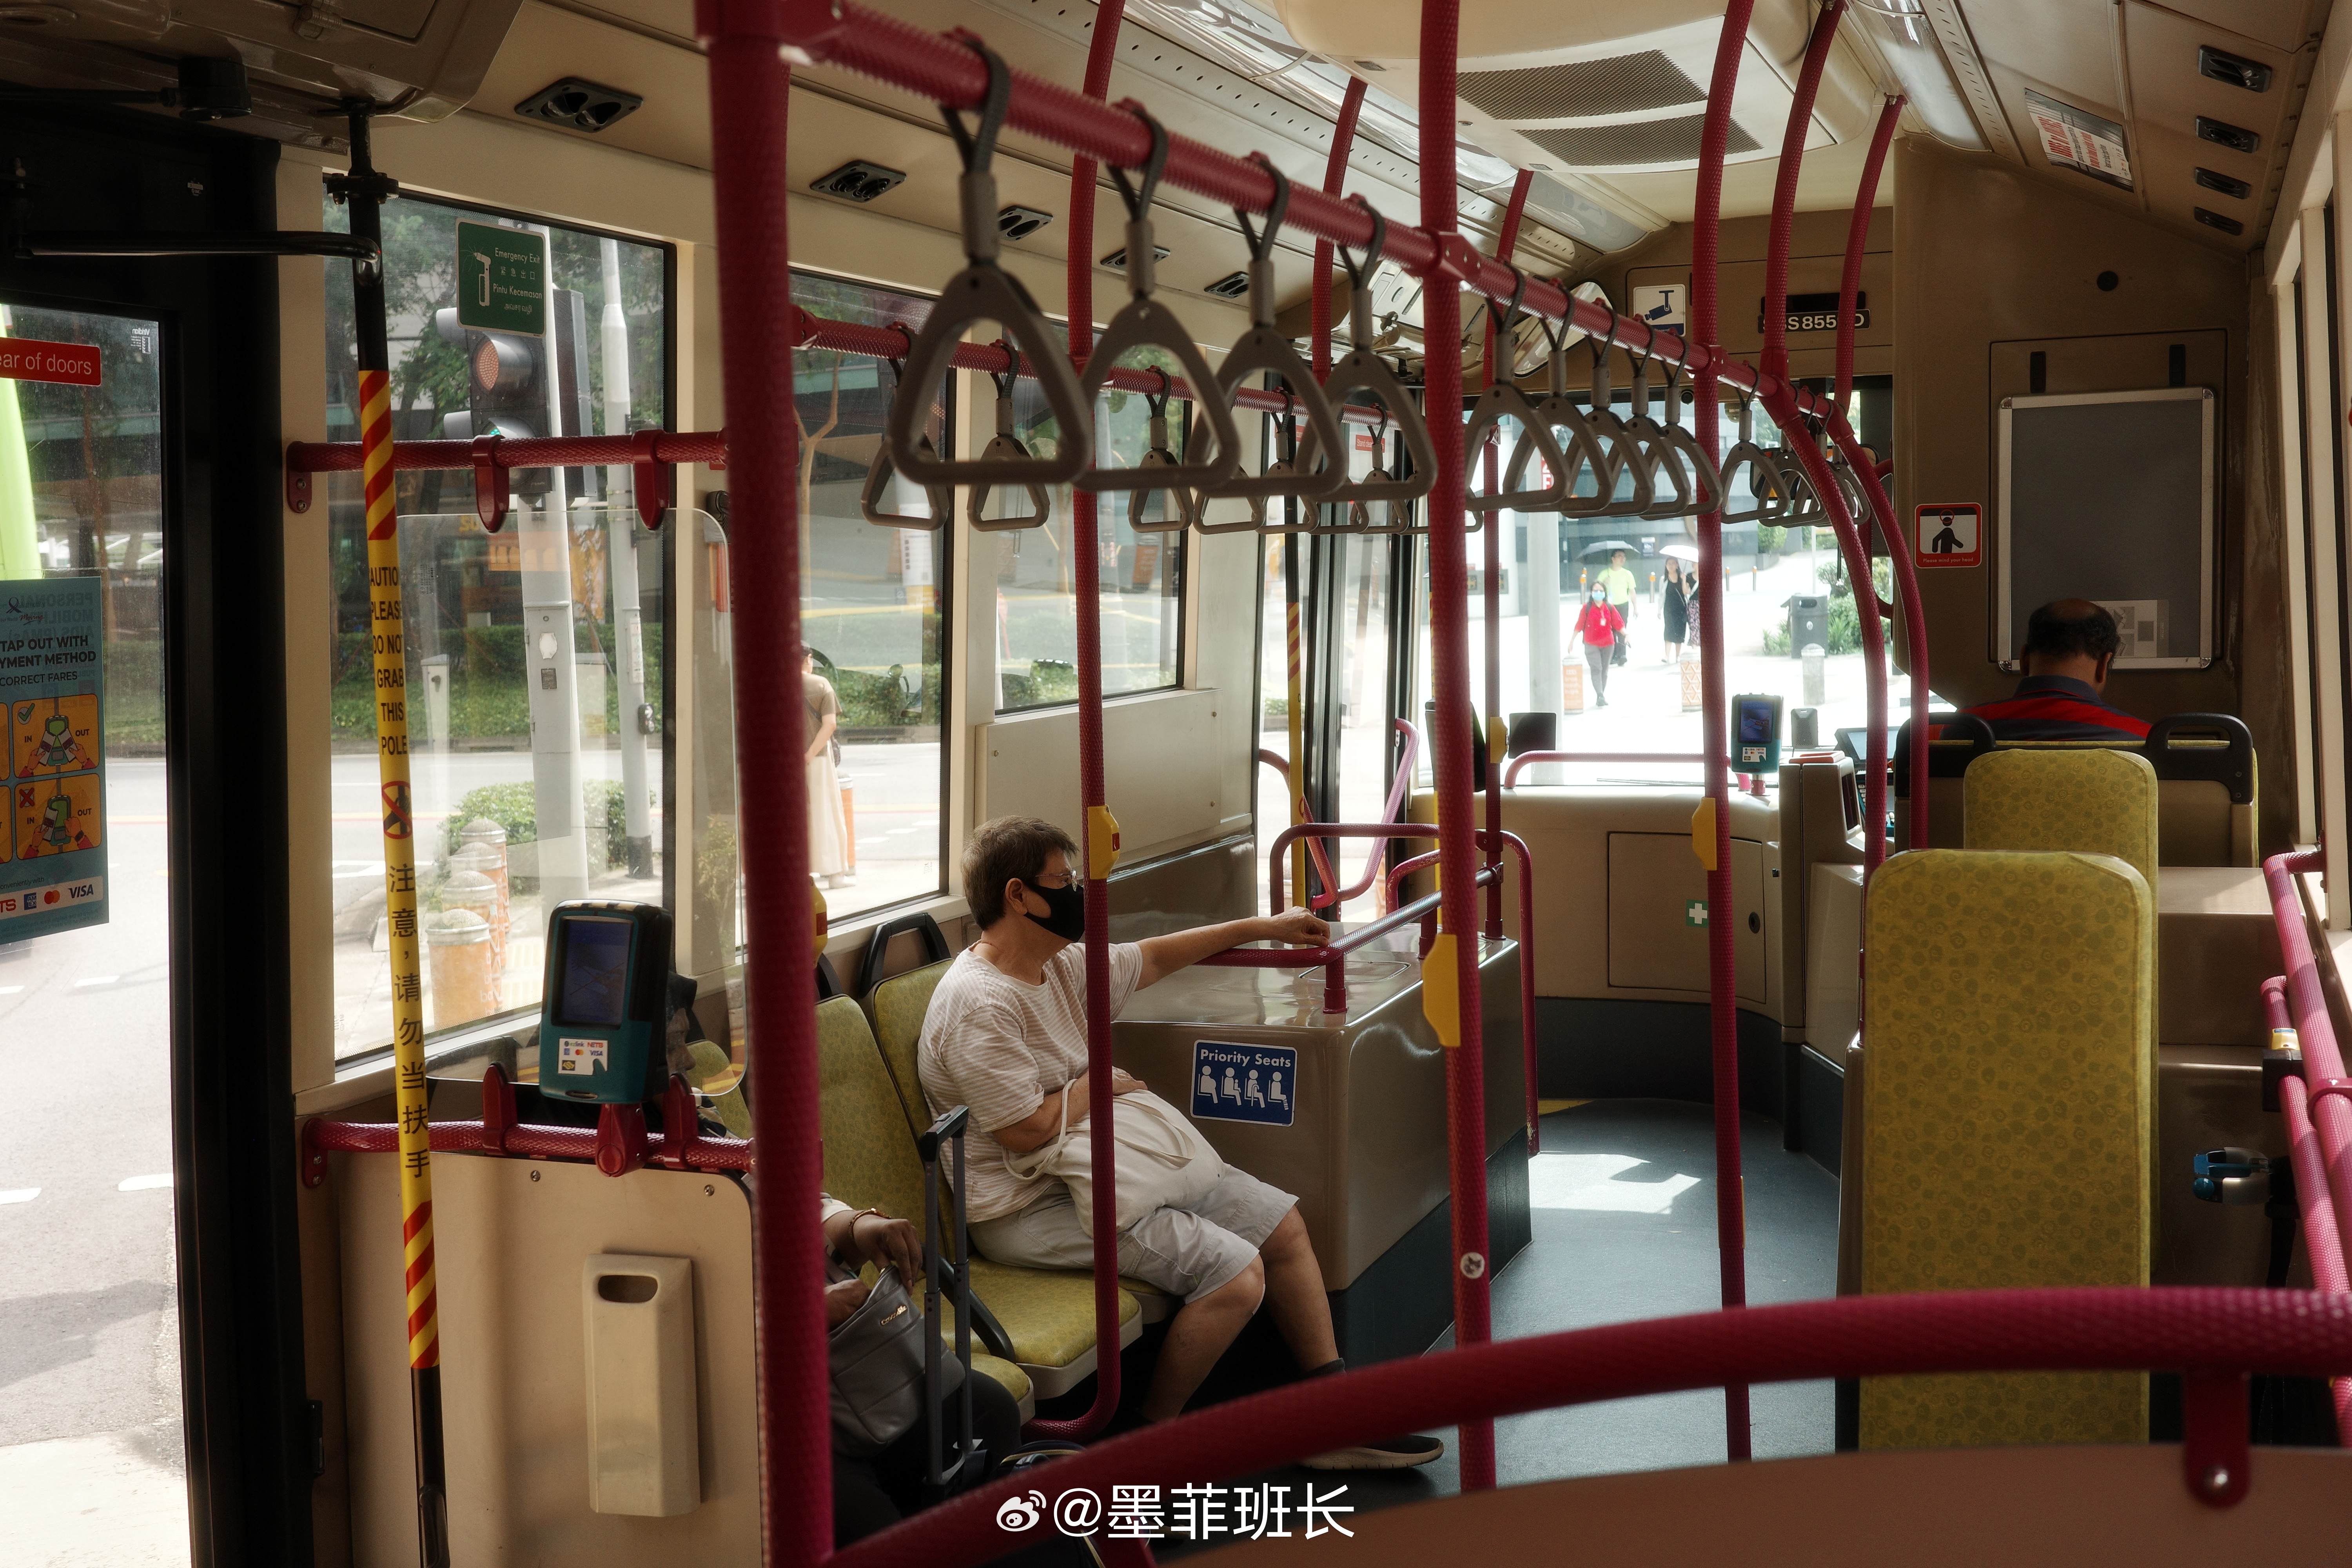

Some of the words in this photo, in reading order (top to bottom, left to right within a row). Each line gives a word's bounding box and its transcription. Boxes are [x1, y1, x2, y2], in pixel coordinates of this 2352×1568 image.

[495, 247, 528, 264] Emergency
[530, 253, 540, 264] Exit
[493, 283, 508, 294] Pintu
[509, 285, 543, 299] Kecemasan
[0, 353, 20, 368] ar
[25, 352, 42, 370] of
[47, 354, 92, 375] doors
[28, 637, 53, 650] OUT
[56, 635, 88, 648] WITH
[45, 651, 96, 665] METHOD
[0, 673, 45, 686] CORRECT
[48, 671, 78, 682] FARES
[377, 668, 404, 688] GRAB
[381, 702, 404, 722] THIS
[75, 729, 90, 737] OUT
[381, 735, 408, 755] POLE
[27, 817, 34, 825] IN
[77, 808, 92, 817] OUT
[67, 884, 94, 899] VISA
[1200, 1049, 1250, 1067] Priority
[1255, 1053, 1291, 1067] Seats
